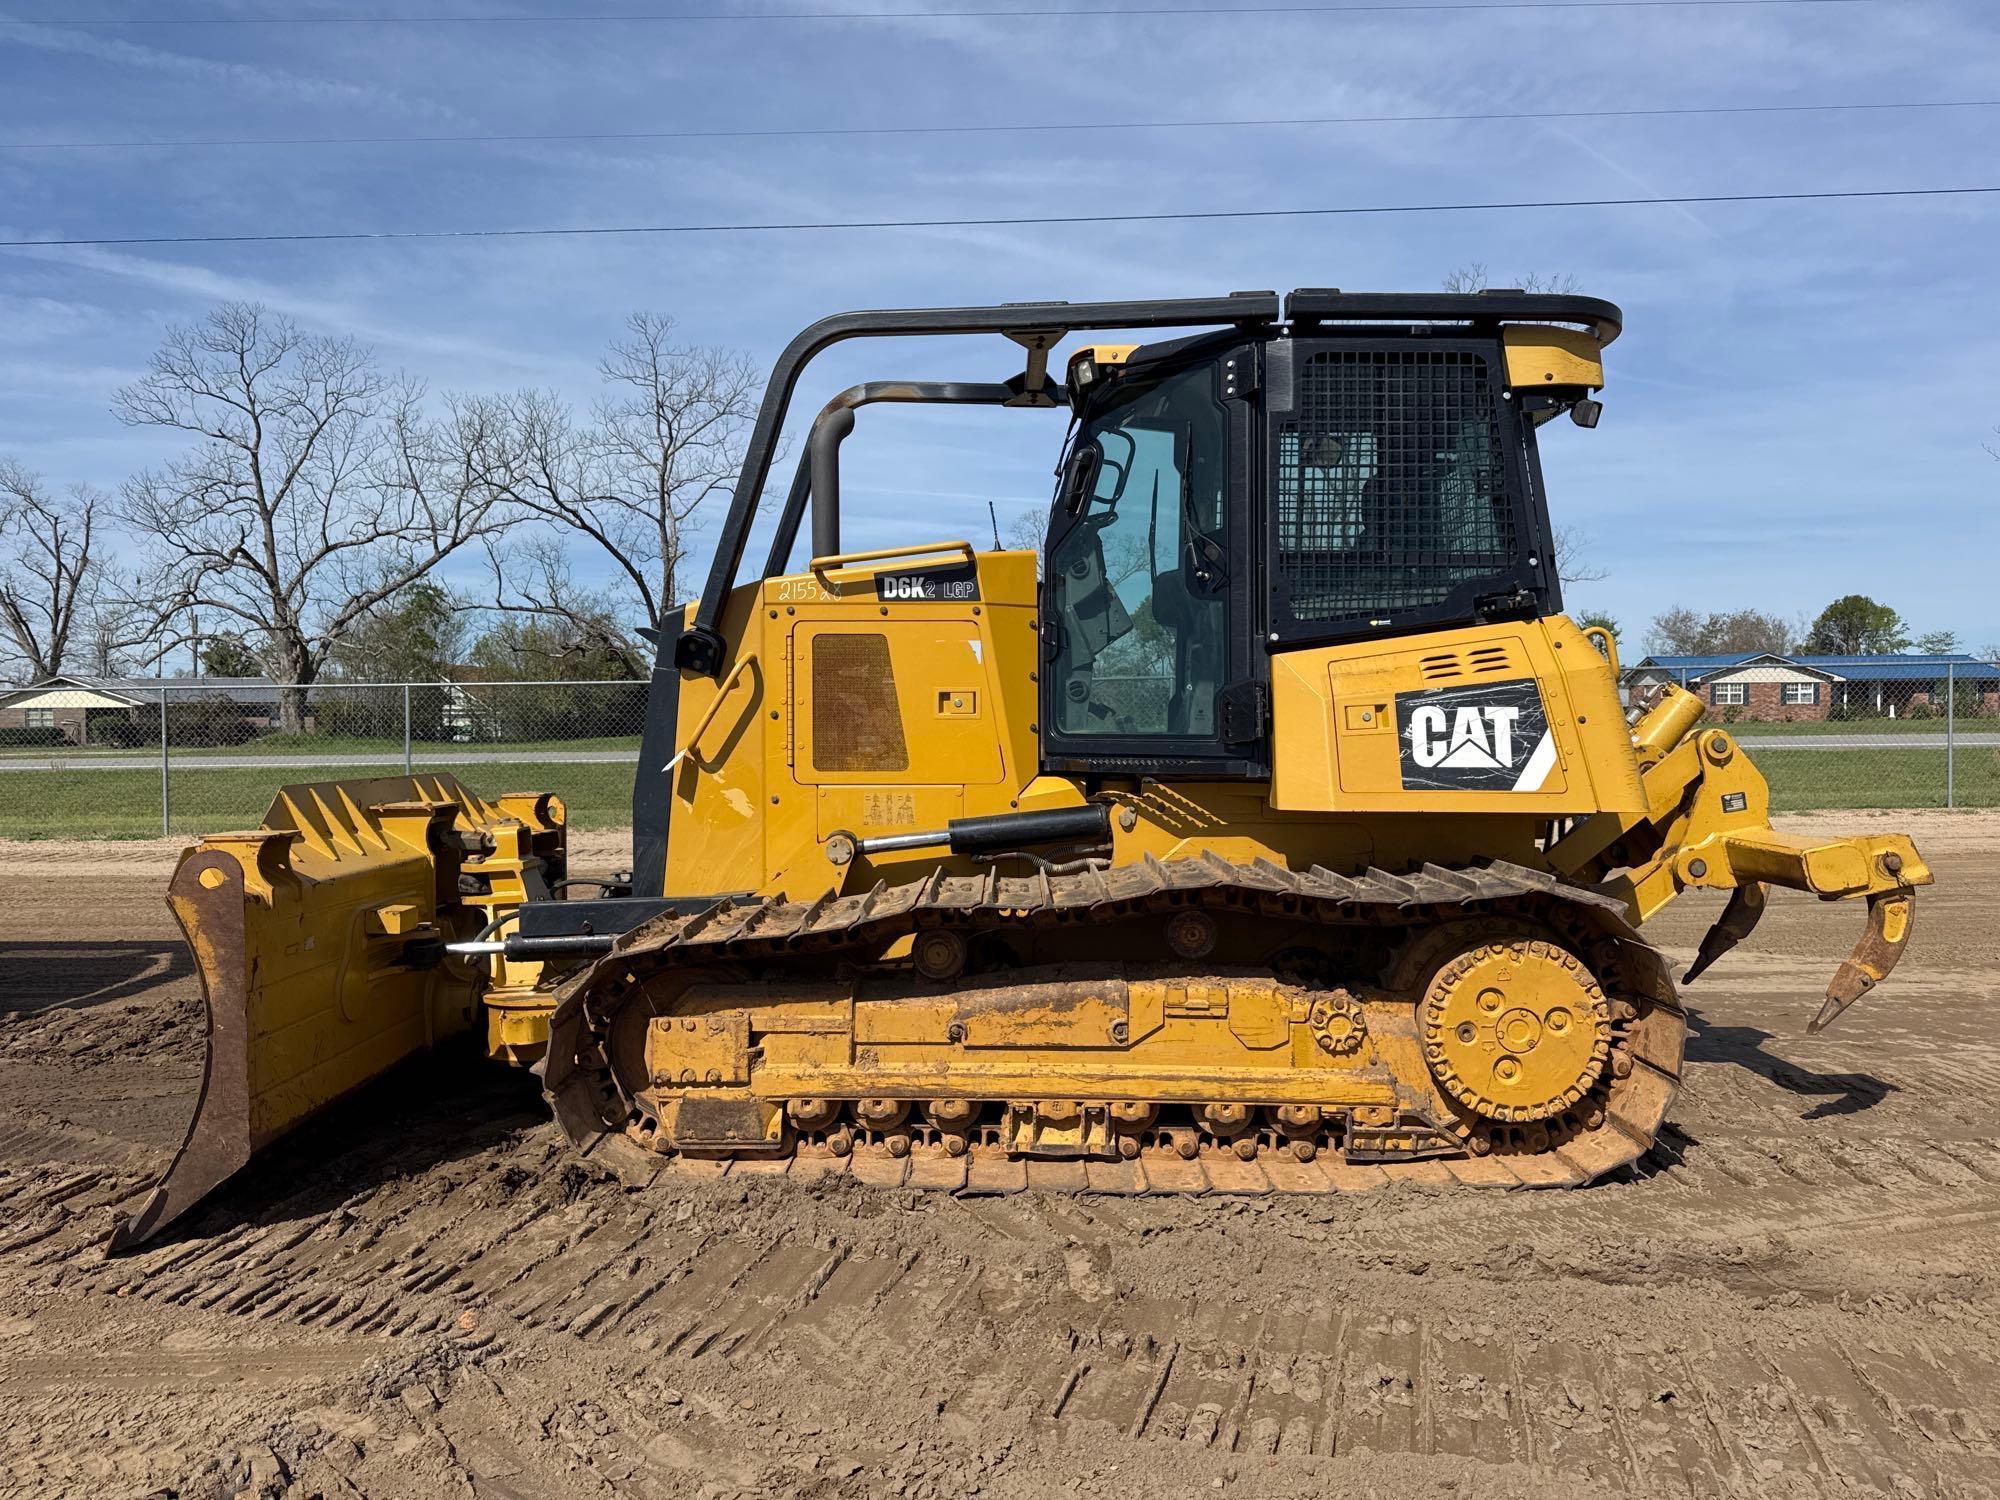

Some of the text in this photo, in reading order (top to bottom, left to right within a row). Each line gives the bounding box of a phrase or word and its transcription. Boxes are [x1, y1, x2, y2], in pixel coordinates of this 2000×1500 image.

[779, 581, 842, 601] 215528
[884, 577, 974, 599] D6K2 LGP
[1411, 705, 1519, 768] CAT
